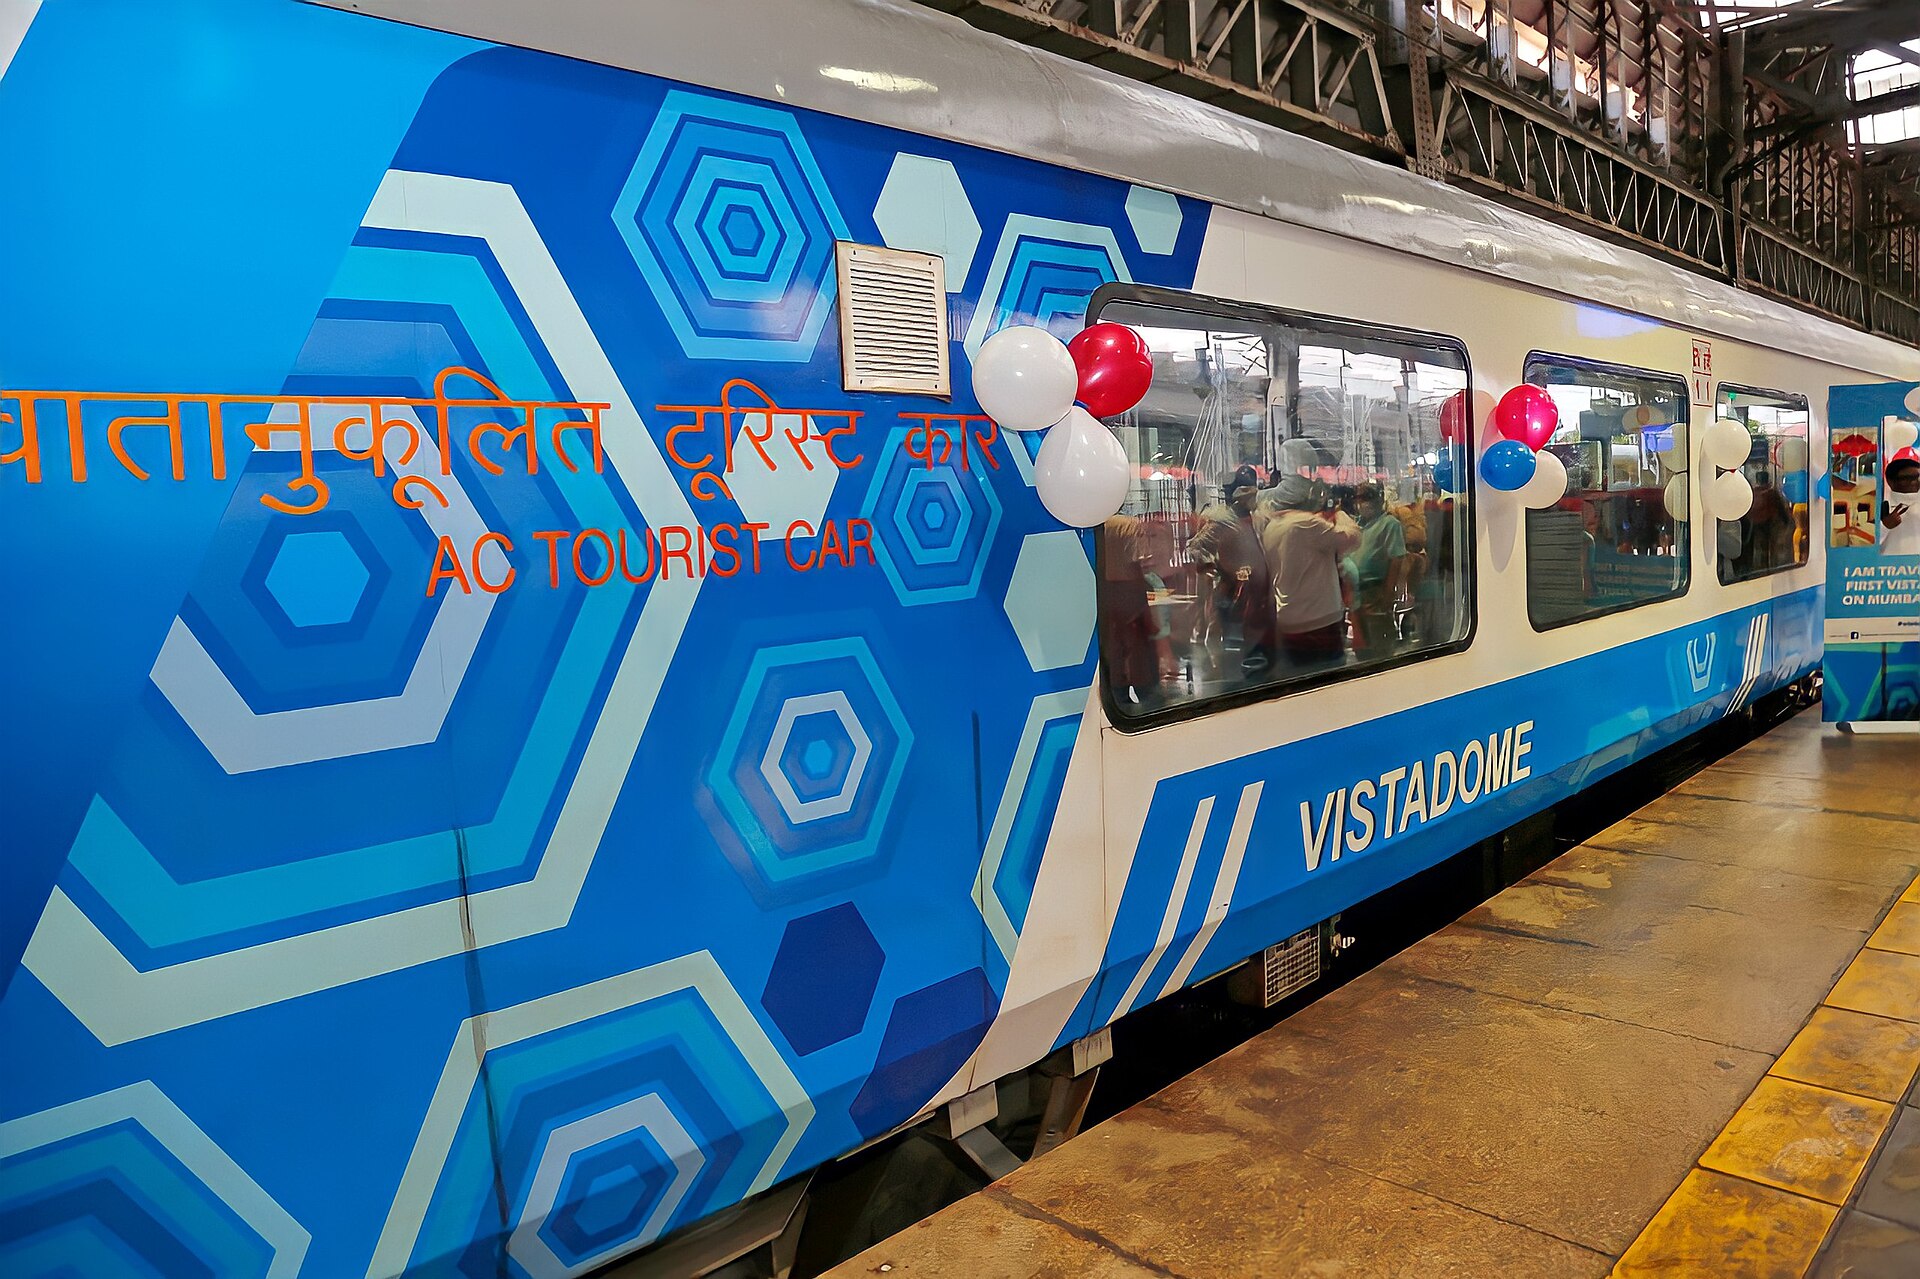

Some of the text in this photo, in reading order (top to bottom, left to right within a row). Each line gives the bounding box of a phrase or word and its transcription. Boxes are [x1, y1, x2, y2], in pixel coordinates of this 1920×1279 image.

[656, 378, 865, 500] टूरिस्ट
[898, 412, 1000, 472] कार
[426, 518, 877, 598] AC TOURIST CAR
[1844, 565, 1920, 577] I AM TRAV
[1842, 594, 1865, 606] ON
[1845, 580, 1884, 592] FIRST
[1299, 719, 1534, 873] VISTADOME
